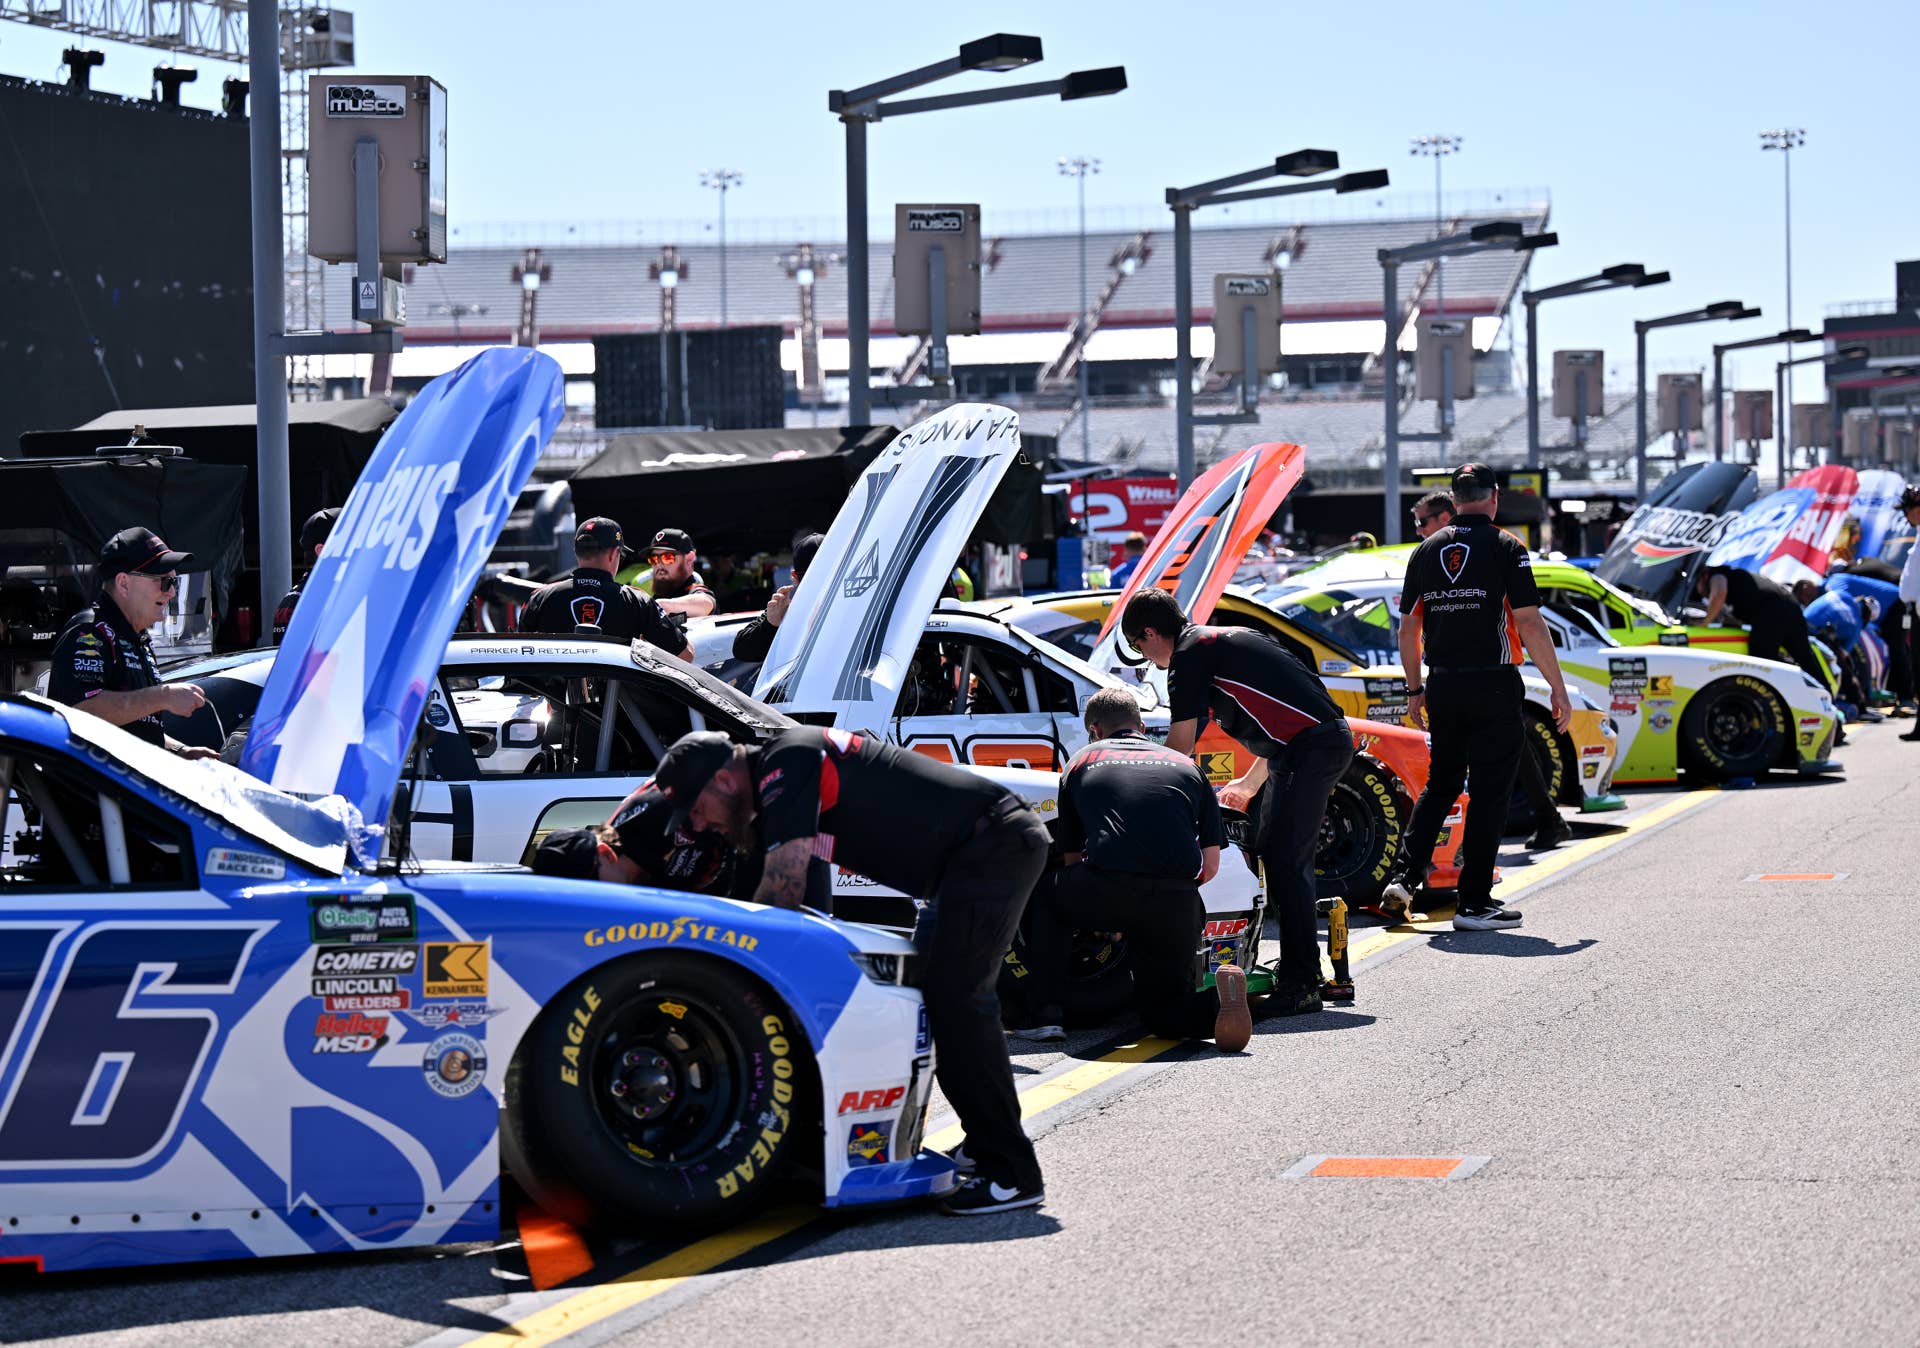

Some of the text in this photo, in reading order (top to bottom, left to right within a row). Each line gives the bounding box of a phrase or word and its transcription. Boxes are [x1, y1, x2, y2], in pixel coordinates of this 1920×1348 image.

[1126, 485, 1179, 499] WHEL
[577, 578, 601, 586] TOYOTA
[1424, 589, 1487, 602] SOUNDGEAR
[1431, 602, 1480, 612] soundgear.com
[470, 647, 518, 655] PARKER
[1368, 705, 1408, 715] COMETIC
[1087, 760, 1177, 771] MOTORSPORTS
[1535, 722, 1564, 797] GOODYEA
[1364, 774, 1400, 881] GOODYEAR
[217, 863, 274, 875] RACE CAR
[381, 907, 407, 917] AUTO
[379, 916, 410, 927] PARTS
[1203, 919, 1248, 937] ARP
[584, 917, 759, 951] GOODYEAR
[316, 949, 417, 971] COMETIC
[315, 977, 394, 994] LINCOLN
[426, 985, 486, 995] KENNAMETAL
[333, 995, 401, 1010] WELDERS
[315, 1013, 389, 1038] Holley
[313, 1035, 377, 1053] MSD
[430, 1034, 481, 1056] CHAMPION
[561, 986, 603, 1087] EAGLE
[428, 1071, 482, 1095] IRRIGATION
[716, 1014, 793, 1199] GOODYEAR
[838, 1086, 905, 1114] ARP
